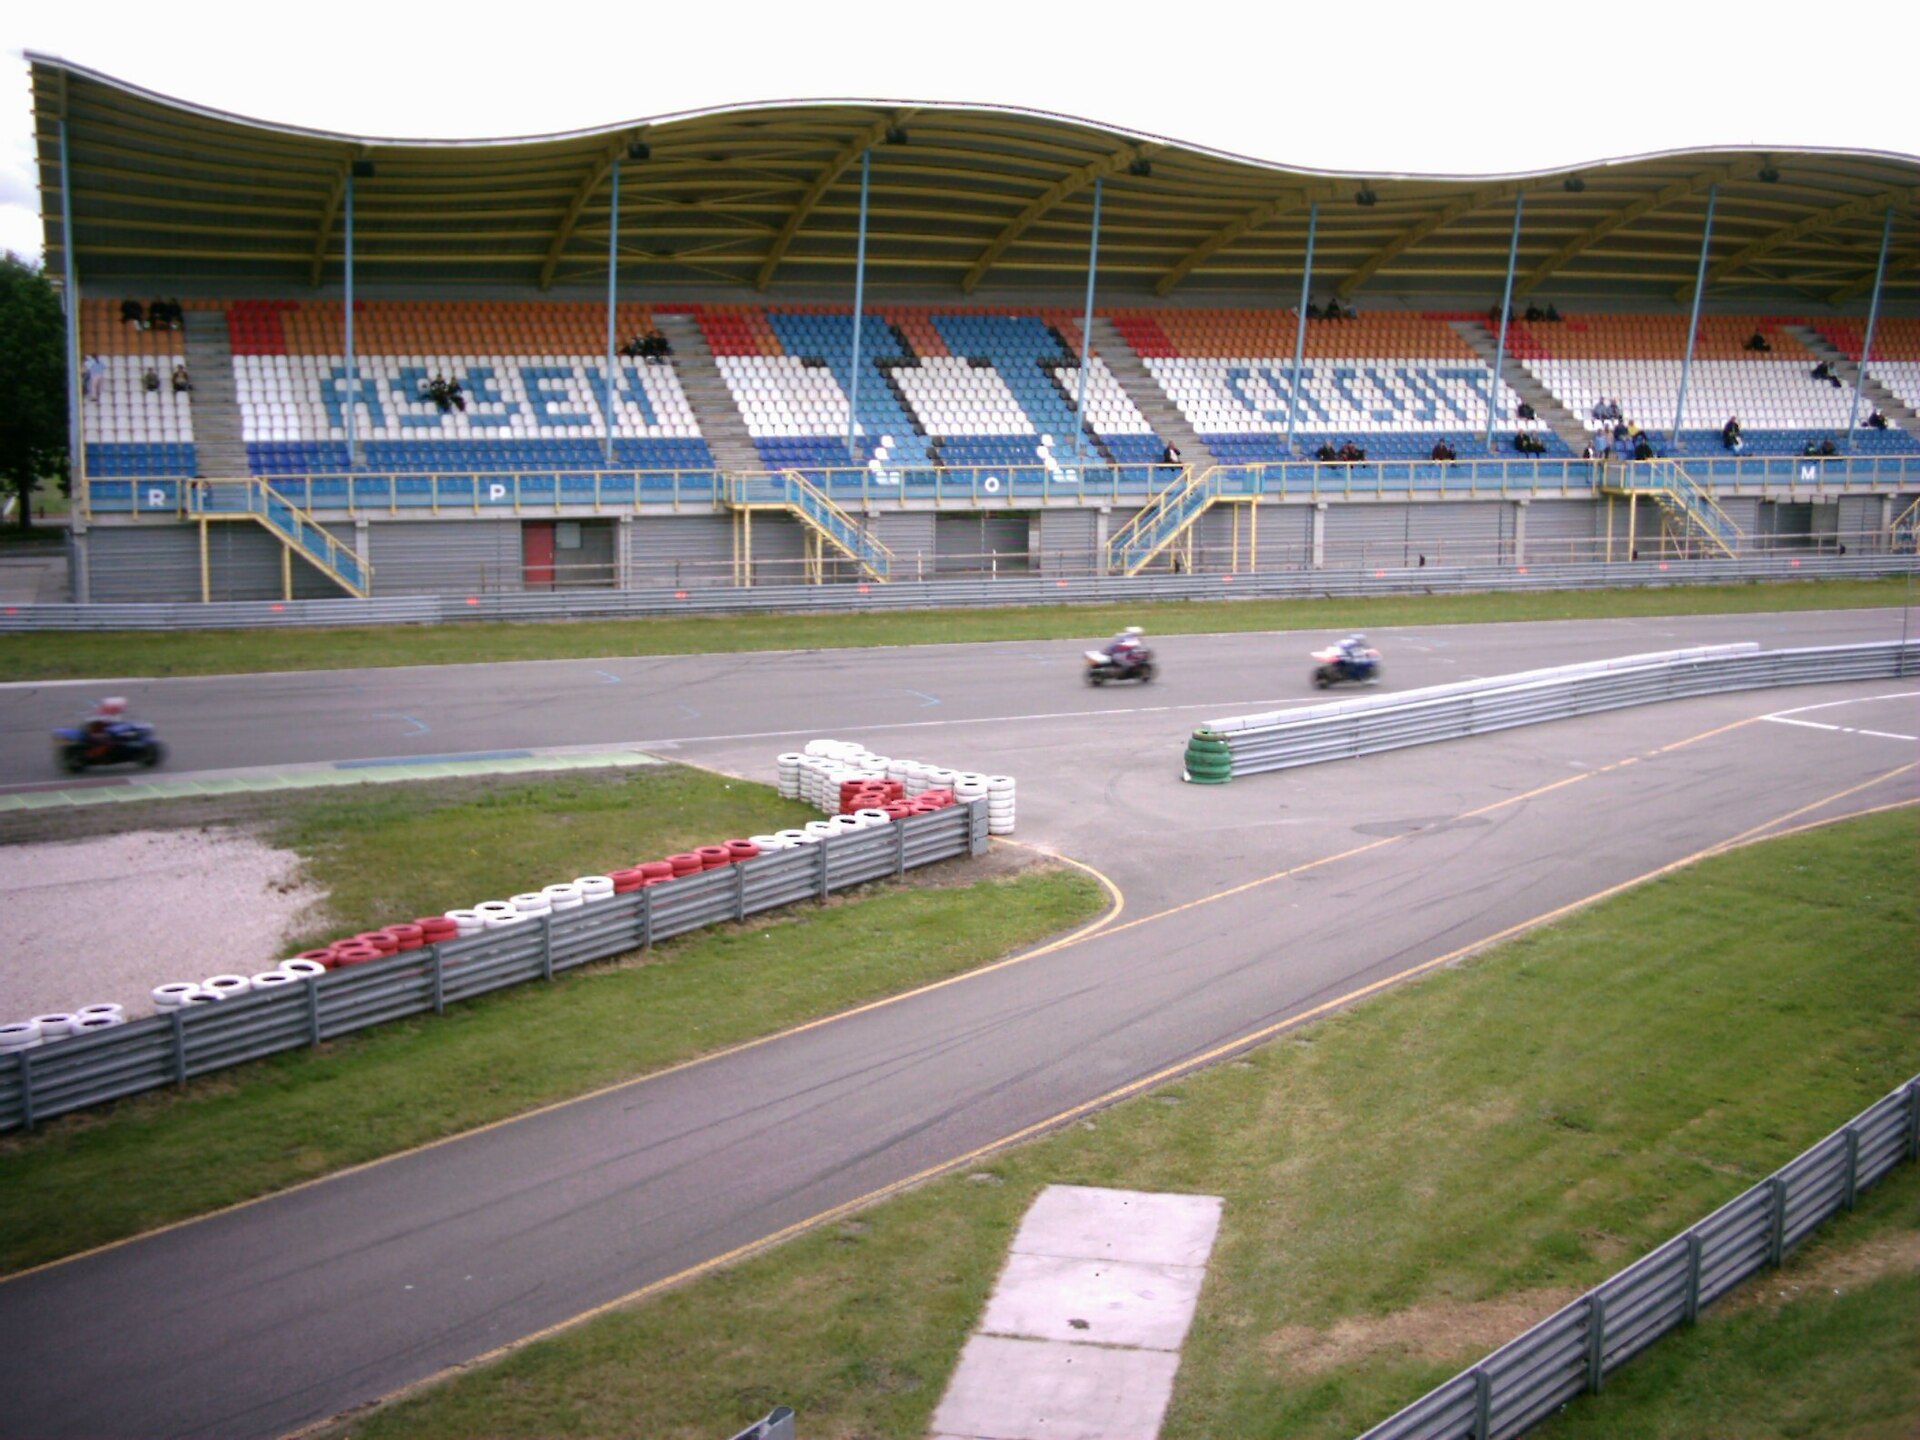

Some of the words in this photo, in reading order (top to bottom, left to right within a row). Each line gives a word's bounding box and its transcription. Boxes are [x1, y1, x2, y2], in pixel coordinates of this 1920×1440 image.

[321, 365, 660, 427] ASSEN
[1801, 466, 1815, 481] M
[490, 484, 506, 501] P
[984, 476, 1000, 493] O
[148, 488, 165, 507] R
